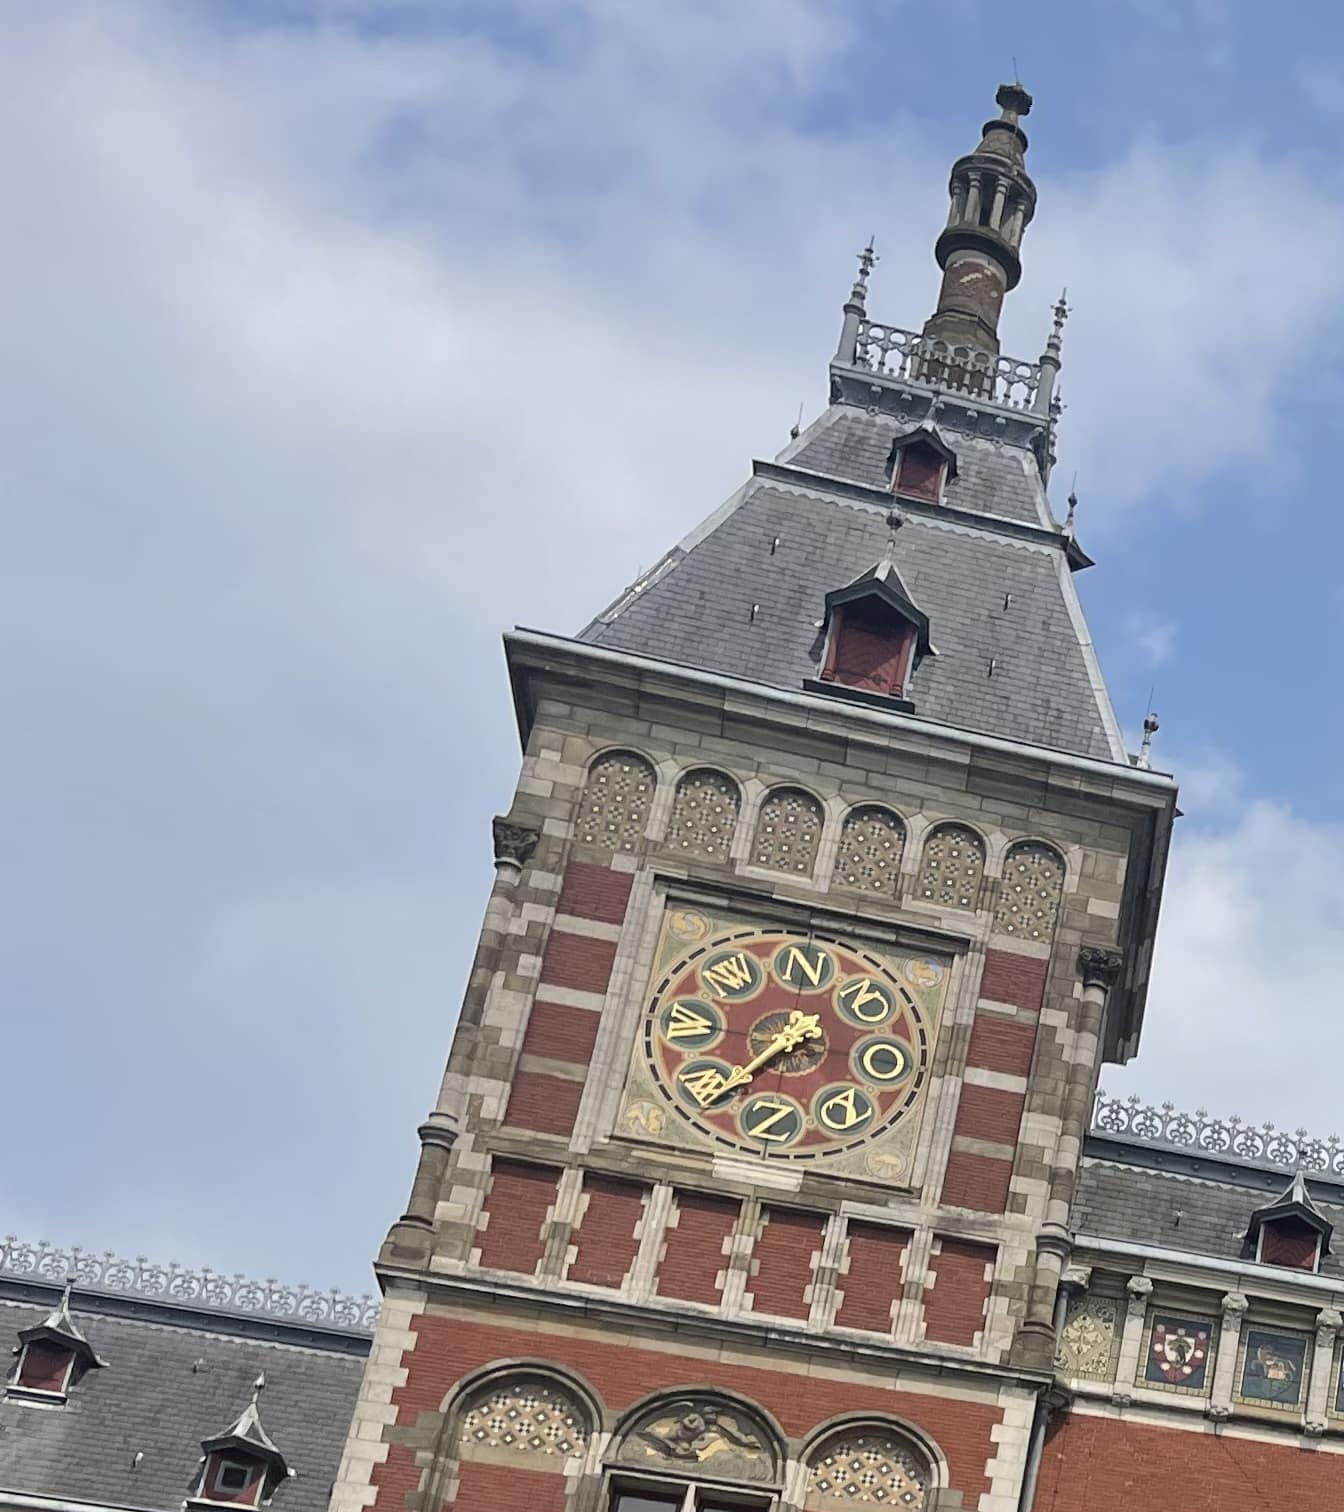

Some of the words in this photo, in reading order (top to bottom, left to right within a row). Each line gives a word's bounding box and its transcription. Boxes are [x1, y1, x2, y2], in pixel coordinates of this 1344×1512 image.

[781, 946, 827, 987] N
[666, 1002, 713, 1040] W
[862, 1043, 905, 1079] O
